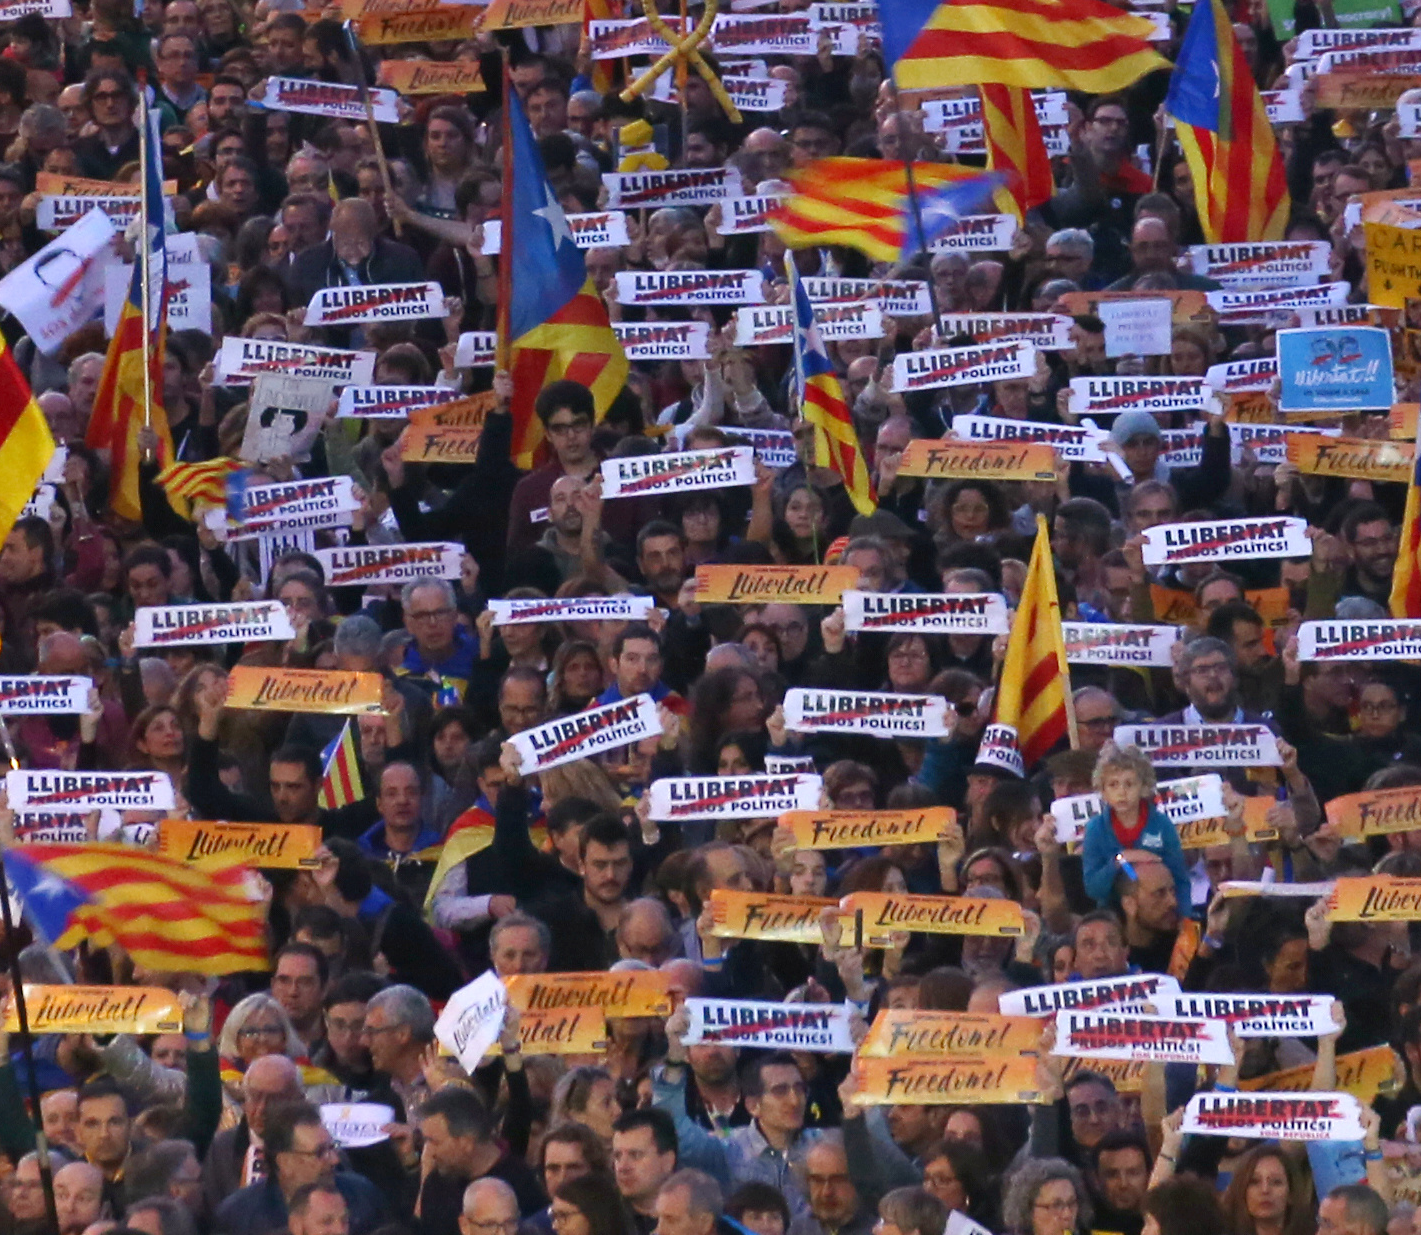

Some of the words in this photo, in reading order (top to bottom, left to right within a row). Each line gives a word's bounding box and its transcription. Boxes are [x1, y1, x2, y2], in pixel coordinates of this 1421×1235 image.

[635, 273, 746, 290] LLIBERTAT
[320, 285, 432, 307] LLIBERTAT
[906, 344, 1021, 376] LLIBERTAT
[1088, 377, 1204, 398] LLIBERTAT
[1165, 521, 1288, 545] LLIBERTAT
[331, 545, 447, 568] LLIBERTAT
[152, 605, 274, 628] LLIBERTAT
[863, 596, 988, 616] LLIBERTAT
[802, 693, 928, 716] LLIBERTAT
[527, 702, 643, 751] LLIBERTAT
[1134, 727, 1262, 748] LLIBERTAT
[27, 773, 155, 794] LLIBERTAT
[669, 777, 802, 801] LLIBERTAT
[812, 814, 926, 846] Freedom!
[875, 897, 986, 926] Llibertat!
[702, 1005, 834, 1031] LLIBERTAT
[1175, 998, 1310, 1023] LLIBERTAT
[1069, 1015, 1202, 1040] LLIBERTAT
[1197, 1097, 1340, 1121] LLIBERTAT
